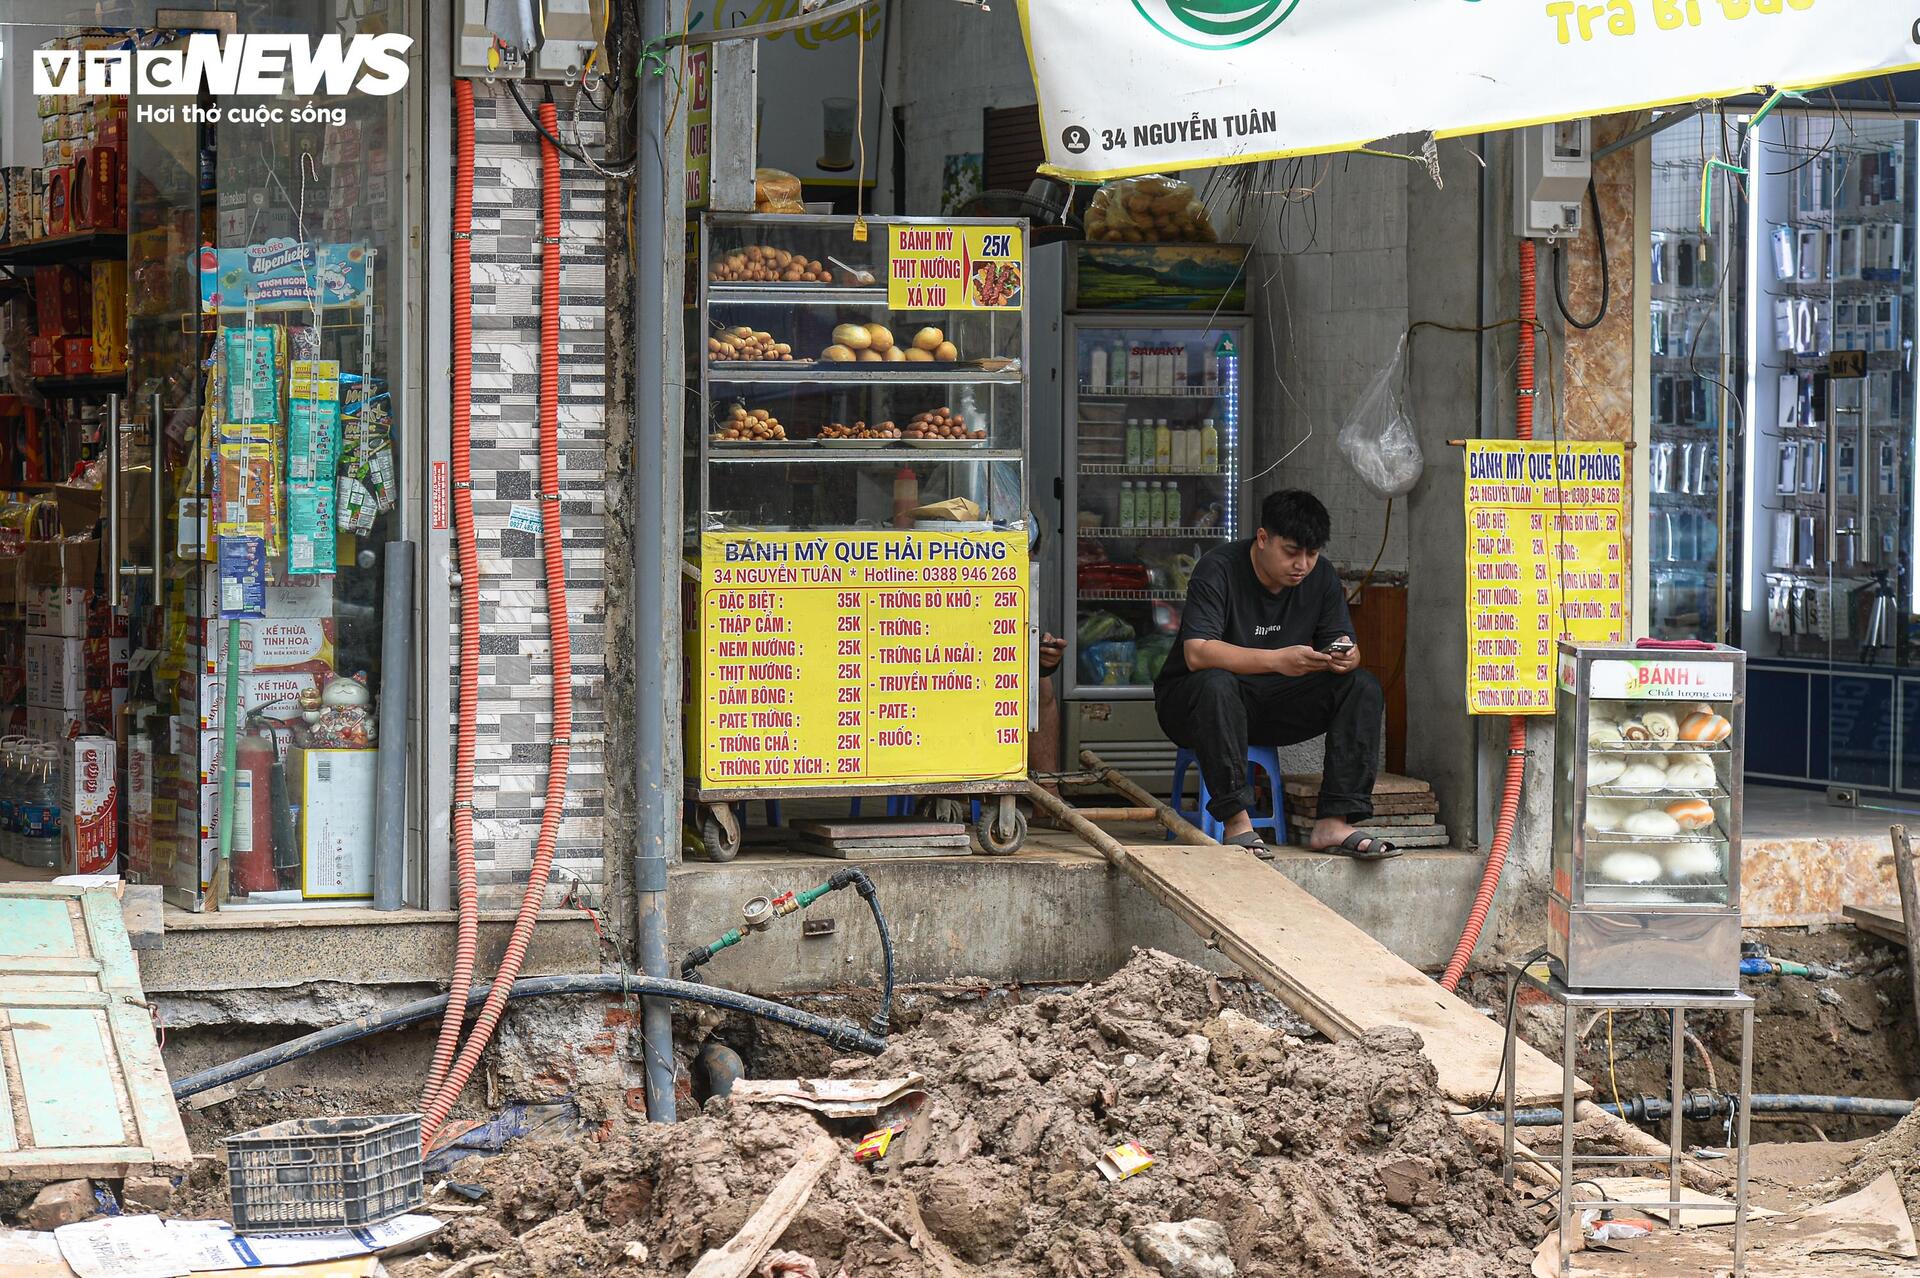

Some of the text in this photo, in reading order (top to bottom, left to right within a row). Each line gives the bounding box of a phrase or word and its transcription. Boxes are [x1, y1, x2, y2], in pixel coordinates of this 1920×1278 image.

[1101, 109, 1278, 151] 34 NGUYỄN TUÂN
[900, 227, 1011, 256] BÁNH MỲ 25K
[892, 256, 960, 282] THỊT NƯỚNG
[907, 284, 946, 306] XÁ XÍU
[1131, 346, 1184, 356] SANAKY
[1470, 446, 1621, 482] BÁNH MỲ QUE HẢI PHÒNG
[1470, 486, 1479, 502] 34
[1511, 483, 1532, 503] TUÂN
[1591, 487, 1605, 503] 946
[1607, 488, 1620, 503] 268
[1477, 511, 1491, 533] ĐẶC
[1531, 514, 1543, 530] 35K
[1575, 513, 1584, 531] BÒ
[1586, 512, 1599, 531] KHÔ
[1606, 516, 1617, 531] 25K
[725, 535, 1006, 563] BÁNH MỲ QUE HẢI PHÒNG
[1533, 539, 1545, 555] 25K
[1608, 545, 1619, 560] 20K
[714, 564, 1017, 583] 34 NGUYỄN TUÂN Hotline: 0388 946 268
[1477, 564, 1493, 580] NEM
[1535, 564, 1547, 580] 25K
[1609, 574, 1620, 589] 20K
[719, 592, 861, 612] ĐẶC BIỆT 35K
[879, 588, 1017, 609] TRỨNG BÒ KHÔ 25K
[1537, 589, 1549, 606] 25K
[1610, 603, 1621, 618] 20K
[266, 624, 306, 635] KẾ THỪA
[719, 611, 861, 636] THẬP CẨM 25K
[879, 617, 1017, 637] TRỨNG 20K
[1537, 614, 1549, 630] 25K
[263, 637, 285, 646] TINH
[288, 637, 309, 645] HOA
[719, 638, 861, 658] NEM NƯỚNG 25K
[1478, 640, 1493, 656] PATE
[1537, 640, 1549, 656] 25K
[879, 642, 1017, 664] TRỨNG LÁ NGẢI 20K
[719, 662, 861, 683] THỊT NƯỚNG 25K
[880, 669, 1018, 692] TRUYỀN THỐNG 20K
[1537, 665, 1548, 681] 25K
[1638, 664, 1689, 685] BÁNH
[258, 680, 298, 690] KẾ THỪA
[255, 693, 277, 701] TINH
[718, 686, 861, 706] DĂM BÔNG 25K
[1538, 690, 1549, 706] 25K
[719, 708, 861, 729] PATE TRỨNG 25K
[879, 701, 1018, 719] PATE 20K
[719, 730, 861, 753] TRỨNG CHẢ 25K
[878, 724, 1019, 746] RUỐC 15K
[719, 756, 861, 775] TRỨNG XÚC XÍCH 25K
